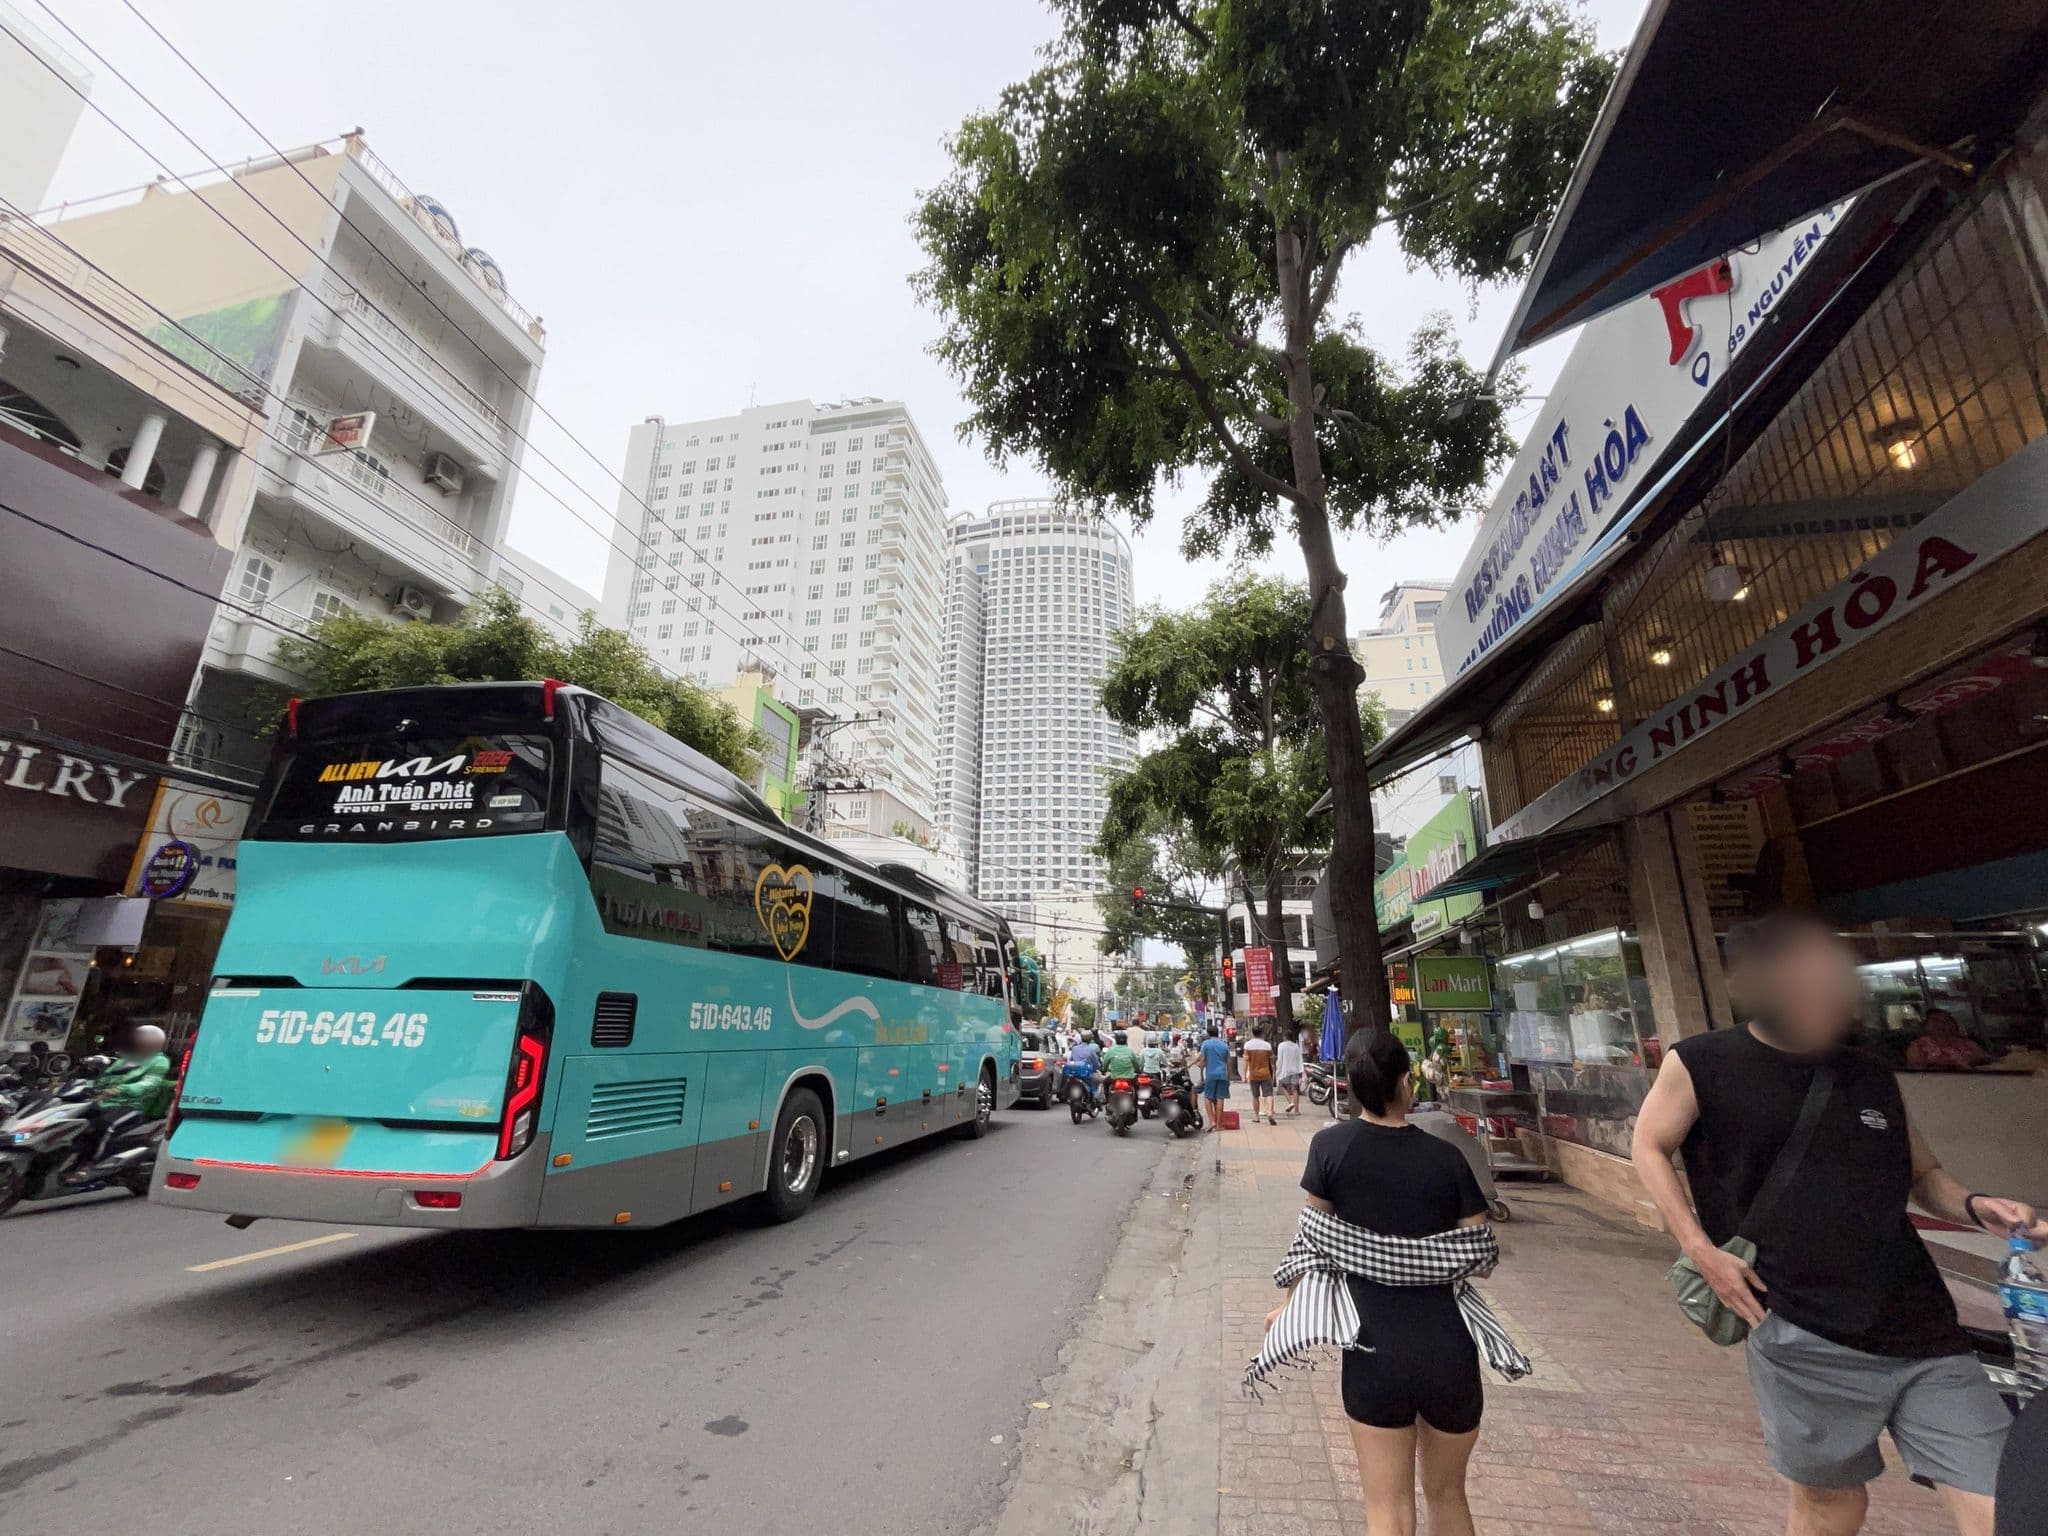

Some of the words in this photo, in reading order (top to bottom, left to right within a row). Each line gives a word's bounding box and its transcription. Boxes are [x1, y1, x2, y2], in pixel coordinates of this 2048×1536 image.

[1584, 403, 1651, 514] HÒA
[1464, 417, 1570, 624] RESTAURANT
[1651, 652, 1771, 758] NINH
[1790, 536, 1978, 669] HÒA
[337, 784, 375, 803] Anh
[379, 779, 424, 801] Tuấn
[427, 780, 475, 799] Phát
[333, 803, 386, 814] Travel
[410, 800, 473, 812] Service
[300, 818, 493, 834] GRANBIRD
[1423, 973, 1483, 993] LanMart
[256, 1009, 429, 1048] 51D-643.46
[690, 1002, 772, 1031] 51D-643.46
